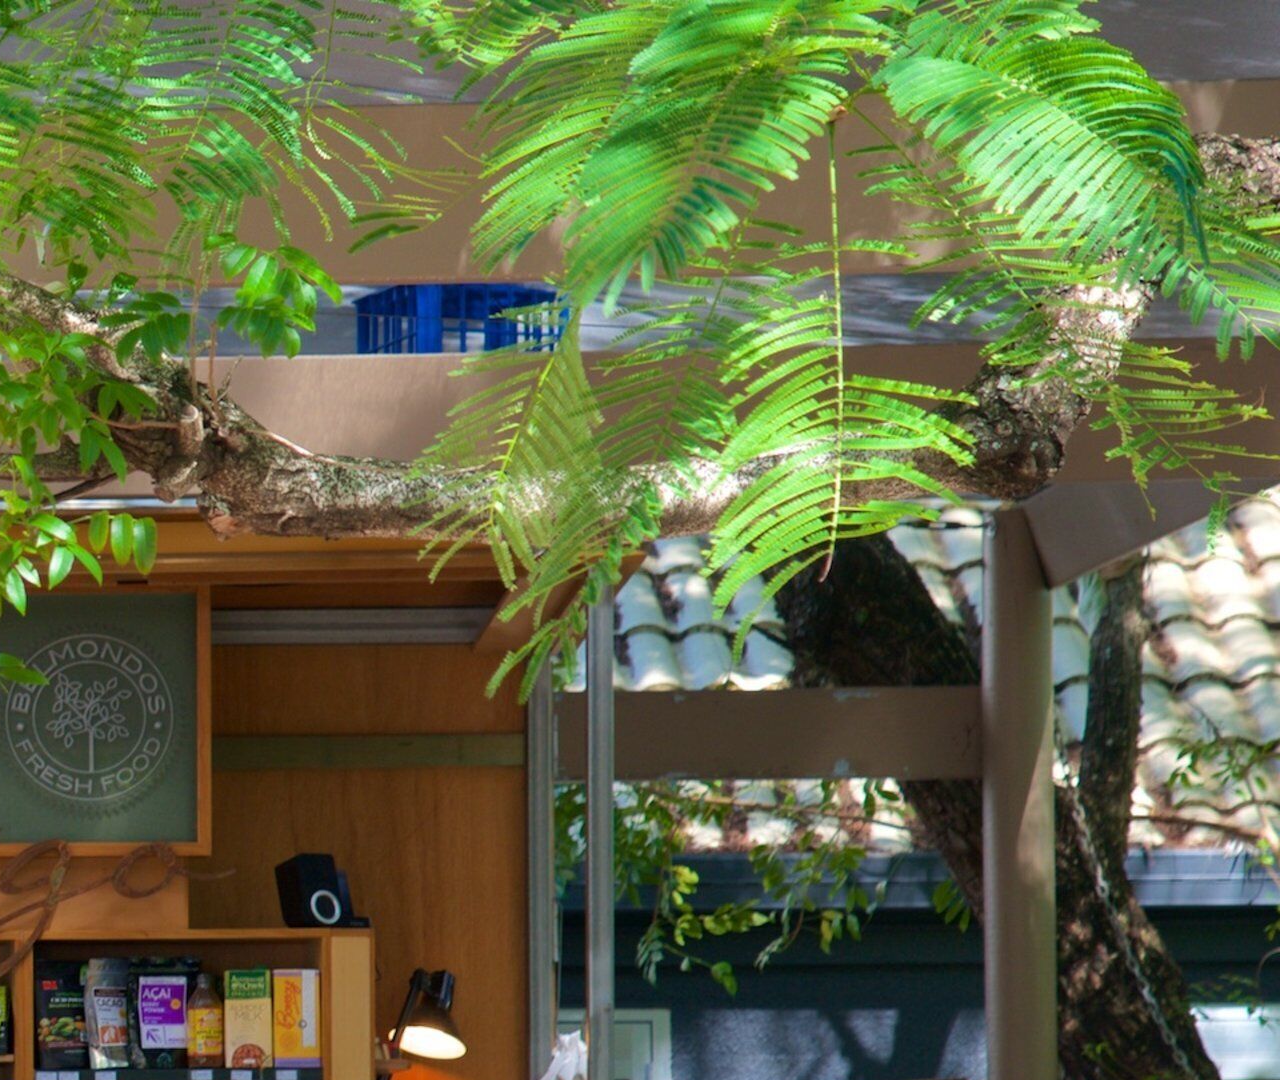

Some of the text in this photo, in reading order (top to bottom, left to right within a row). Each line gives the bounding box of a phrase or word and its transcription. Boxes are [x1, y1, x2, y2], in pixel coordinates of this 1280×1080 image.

[16, 737, 161, 795] FRESH FOOD
[96, 998, 124, 1008] CACAO
